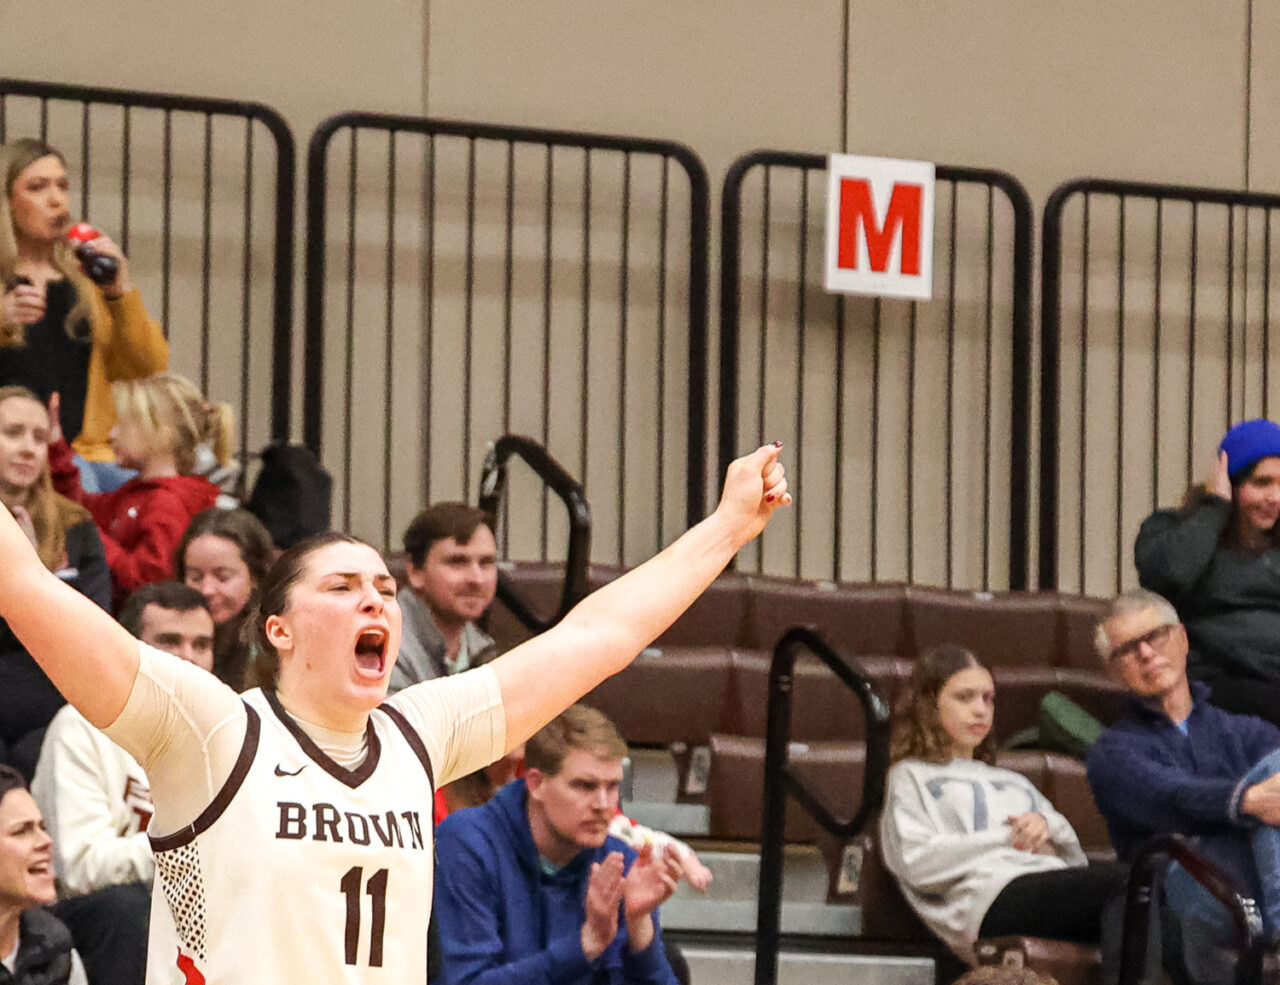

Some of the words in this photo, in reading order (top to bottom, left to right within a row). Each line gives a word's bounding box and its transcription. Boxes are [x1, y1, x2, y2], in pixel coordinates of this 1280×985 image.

[839, 176, 924, 276] M
[275, 800, 424, 850] BROWN
[340, 865, 389, 968] 11
